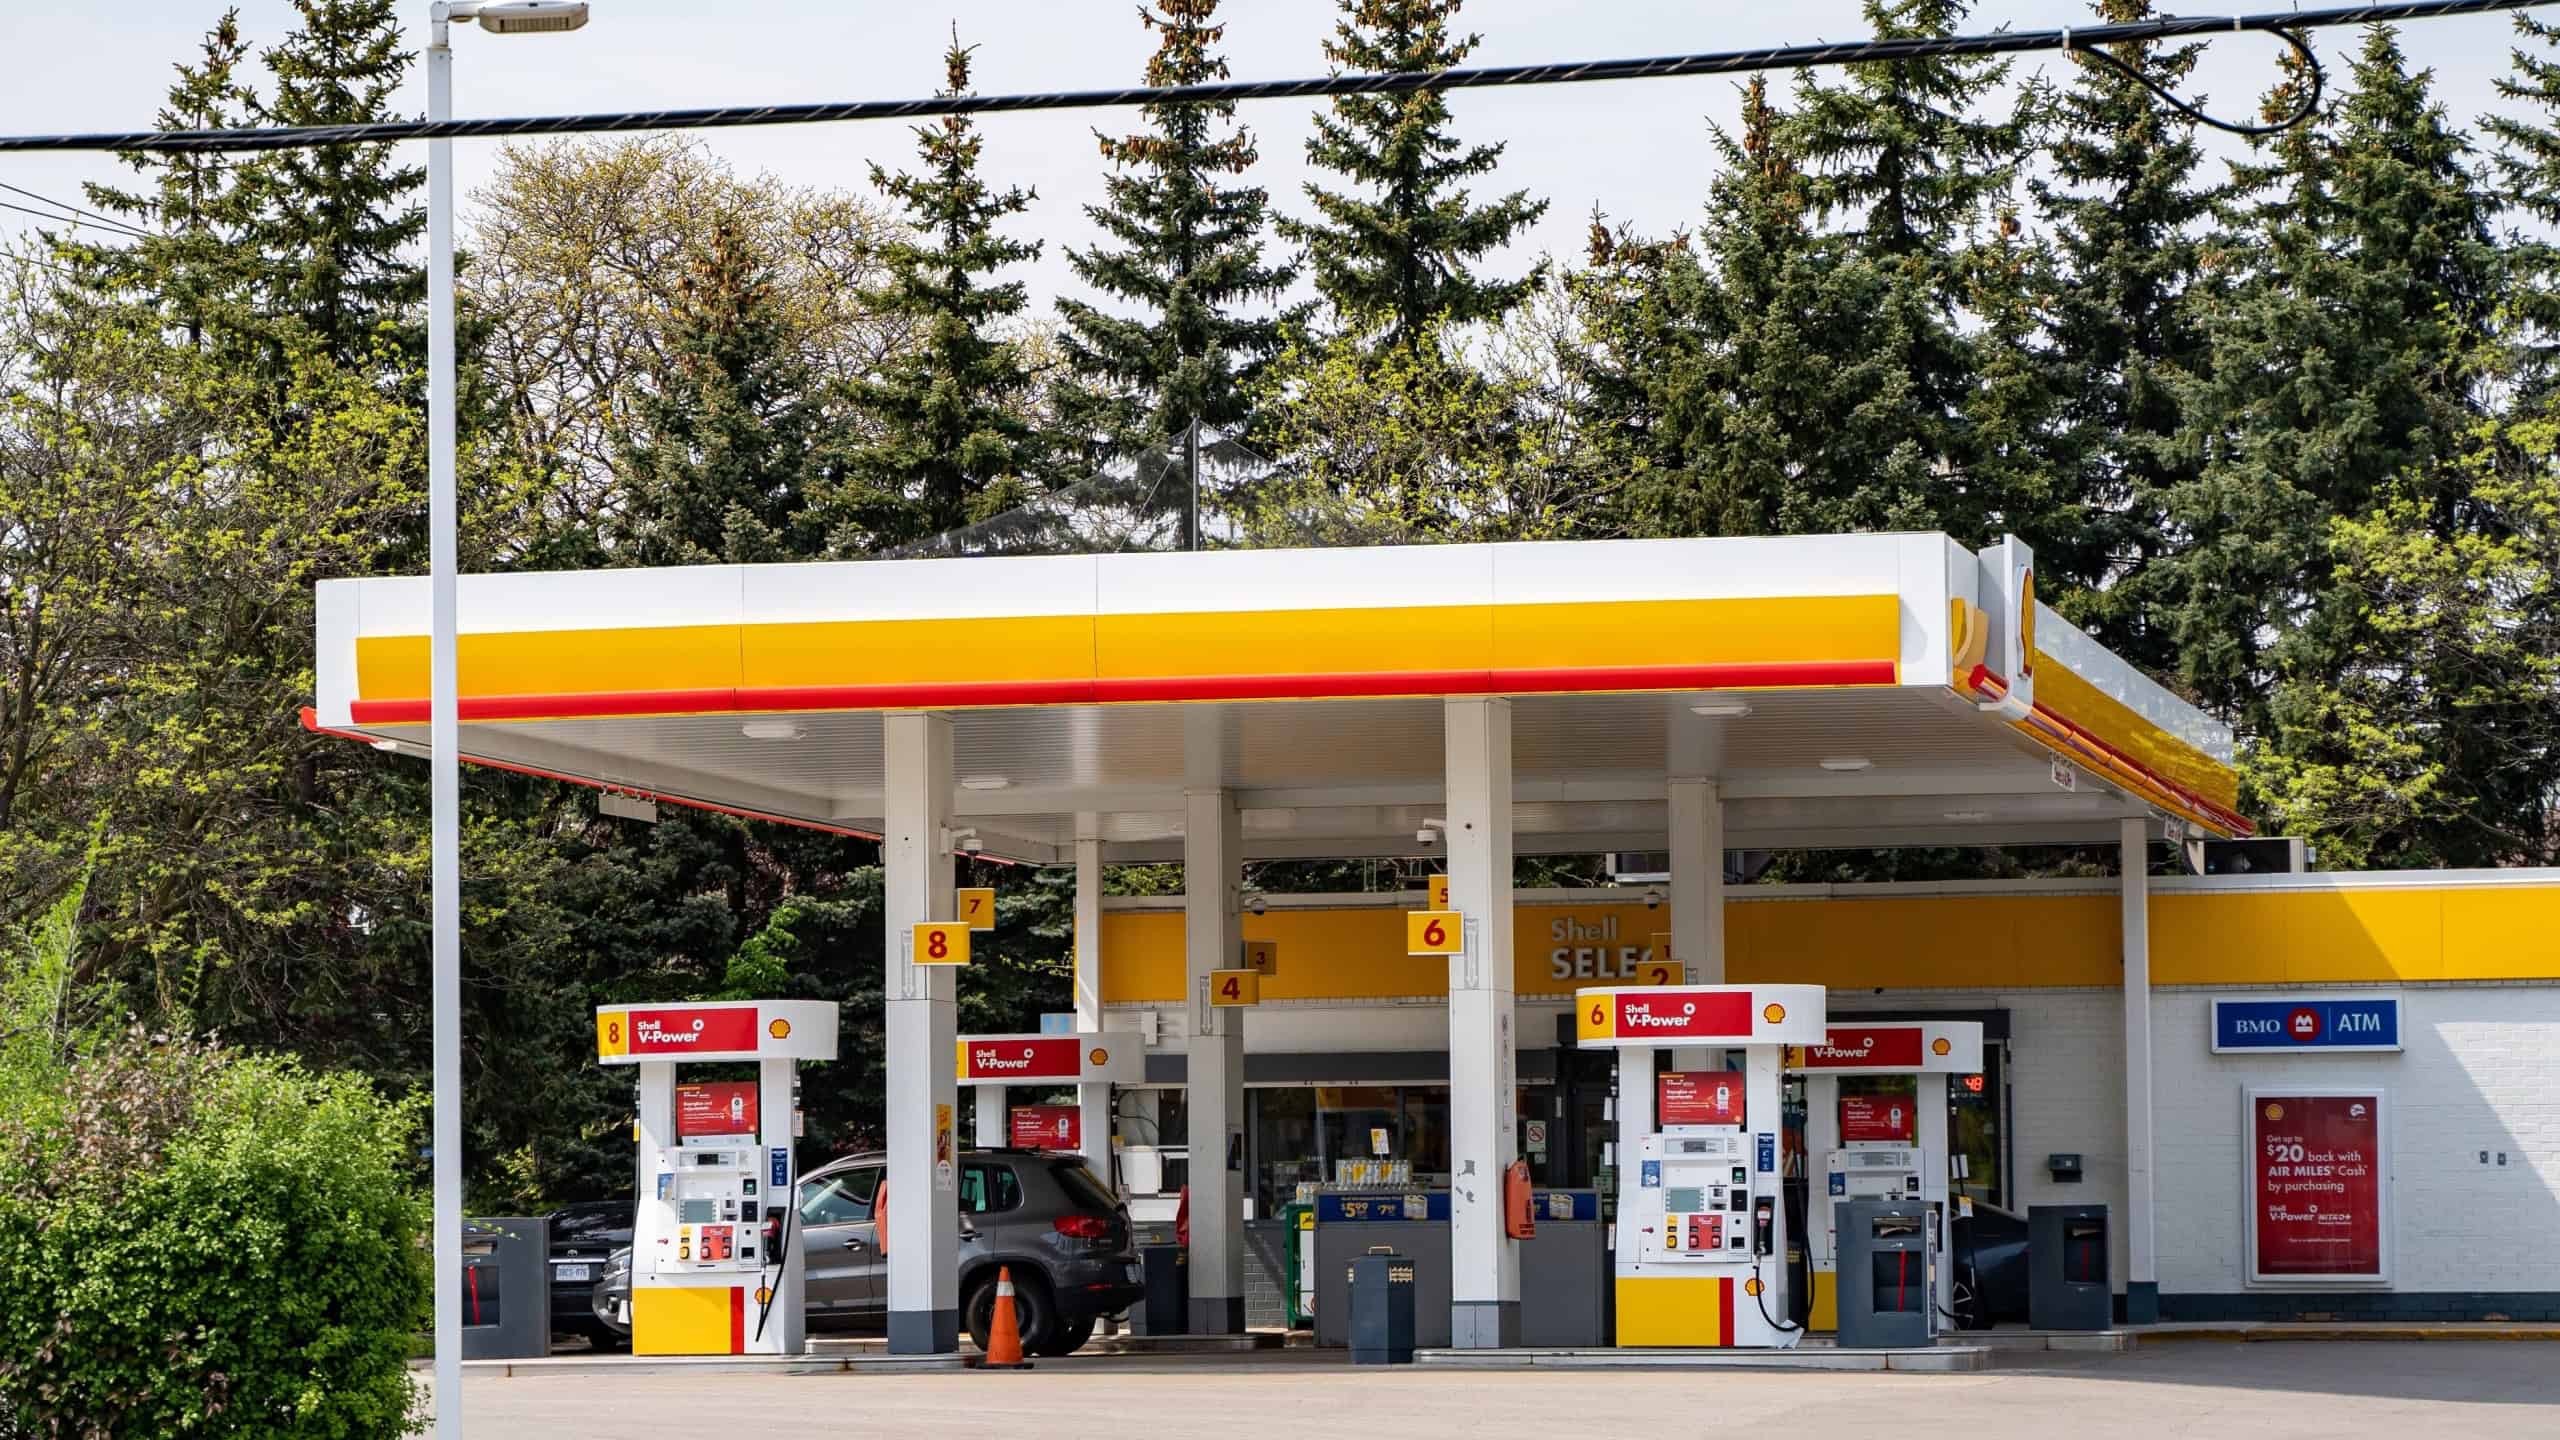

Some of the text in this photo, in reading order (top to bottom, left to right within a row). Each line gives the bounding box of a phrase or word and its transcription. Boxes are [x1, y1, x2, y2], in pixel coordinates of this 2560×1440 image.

[1440, 888, 1448, 904] 5
[969, 898, 982, 914] 7
[1424, 919, 1445, 947] 6
[1552, 917, 1617, 942] Shell
[928, 930, 947, 959] 8
[1663, 944, 1672, 959] 1
[1256, 951, 1265, 965] 3
[1222, 976, 1240, 1001] 4
[1591, 1004, 1604, 1025] 6
[1625, 1003, 1649, 1014] Shell
[637, 1020, 661, 1031] Shell
[1625, 1014, 1690, 1027] V-Power
[2236, 1019, 2281, 1034] BMO
[2338, 1013, 2381, 1032] ATM
[609, 1022, 619, 1044] 8
[638, 1030, 699, 1044] V-Power
[976, 1049, 997, 1058] Shell
[1814, 1047, 1870, 1058] V-Power
[976, 1058, 1030, 1069] V-Power
[2267, 1135, 2281, 1143] Get
[2294, 1135, 2304, 1143] to
[2267, 1144, 2361, 1163] $20 back with
[2268, 1166, 2290, 1177] AIR
[2268, 1180, 2345, 1193] by purchasing
[2270, 1212, 2314, 1221] V-Power
